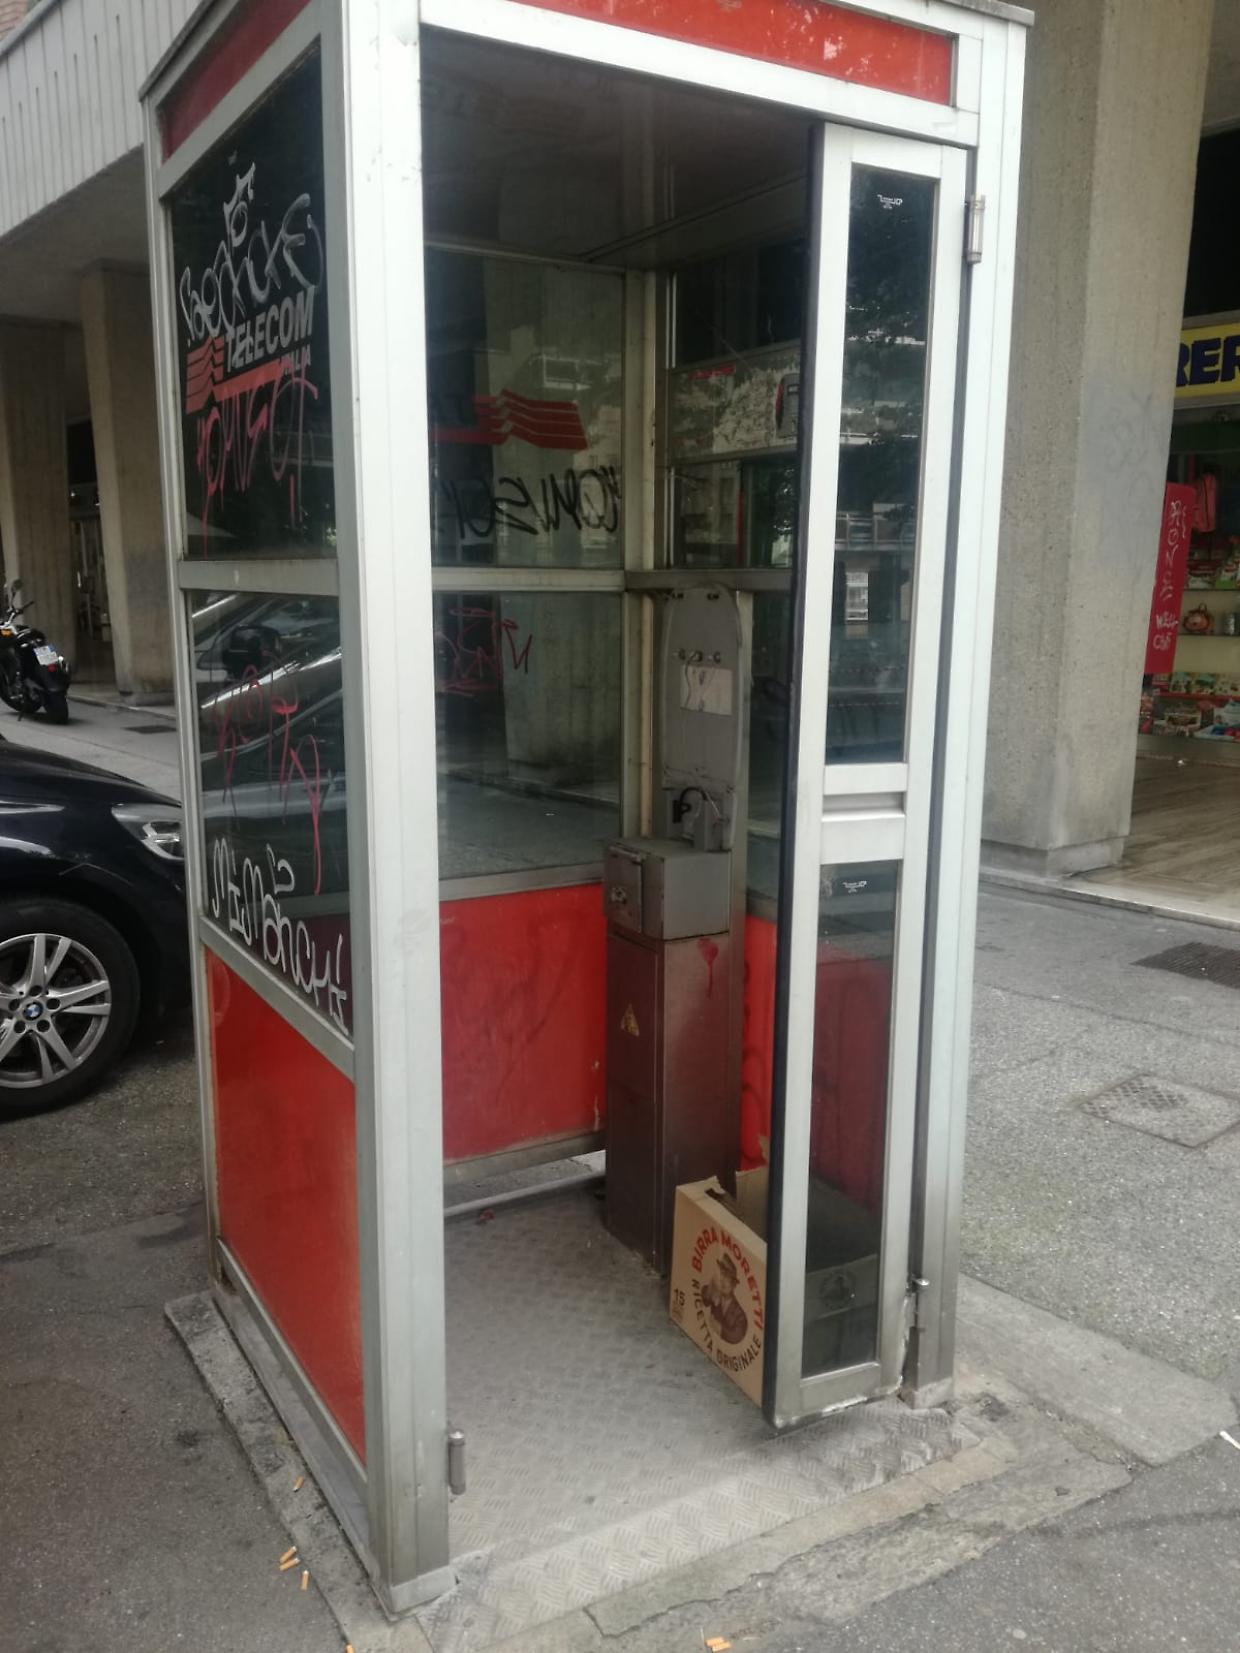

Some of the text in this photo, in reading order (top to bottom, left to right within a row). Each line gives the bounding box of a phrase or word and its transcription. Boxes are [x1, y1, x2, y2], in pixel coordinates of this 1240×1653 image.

[226, 285, 315, 373] TELECOM
[691, 1225, 763, 1329] BIRRA MORETTI
[691, 1279, 762, 1372] RICETTA ORIGINALE
